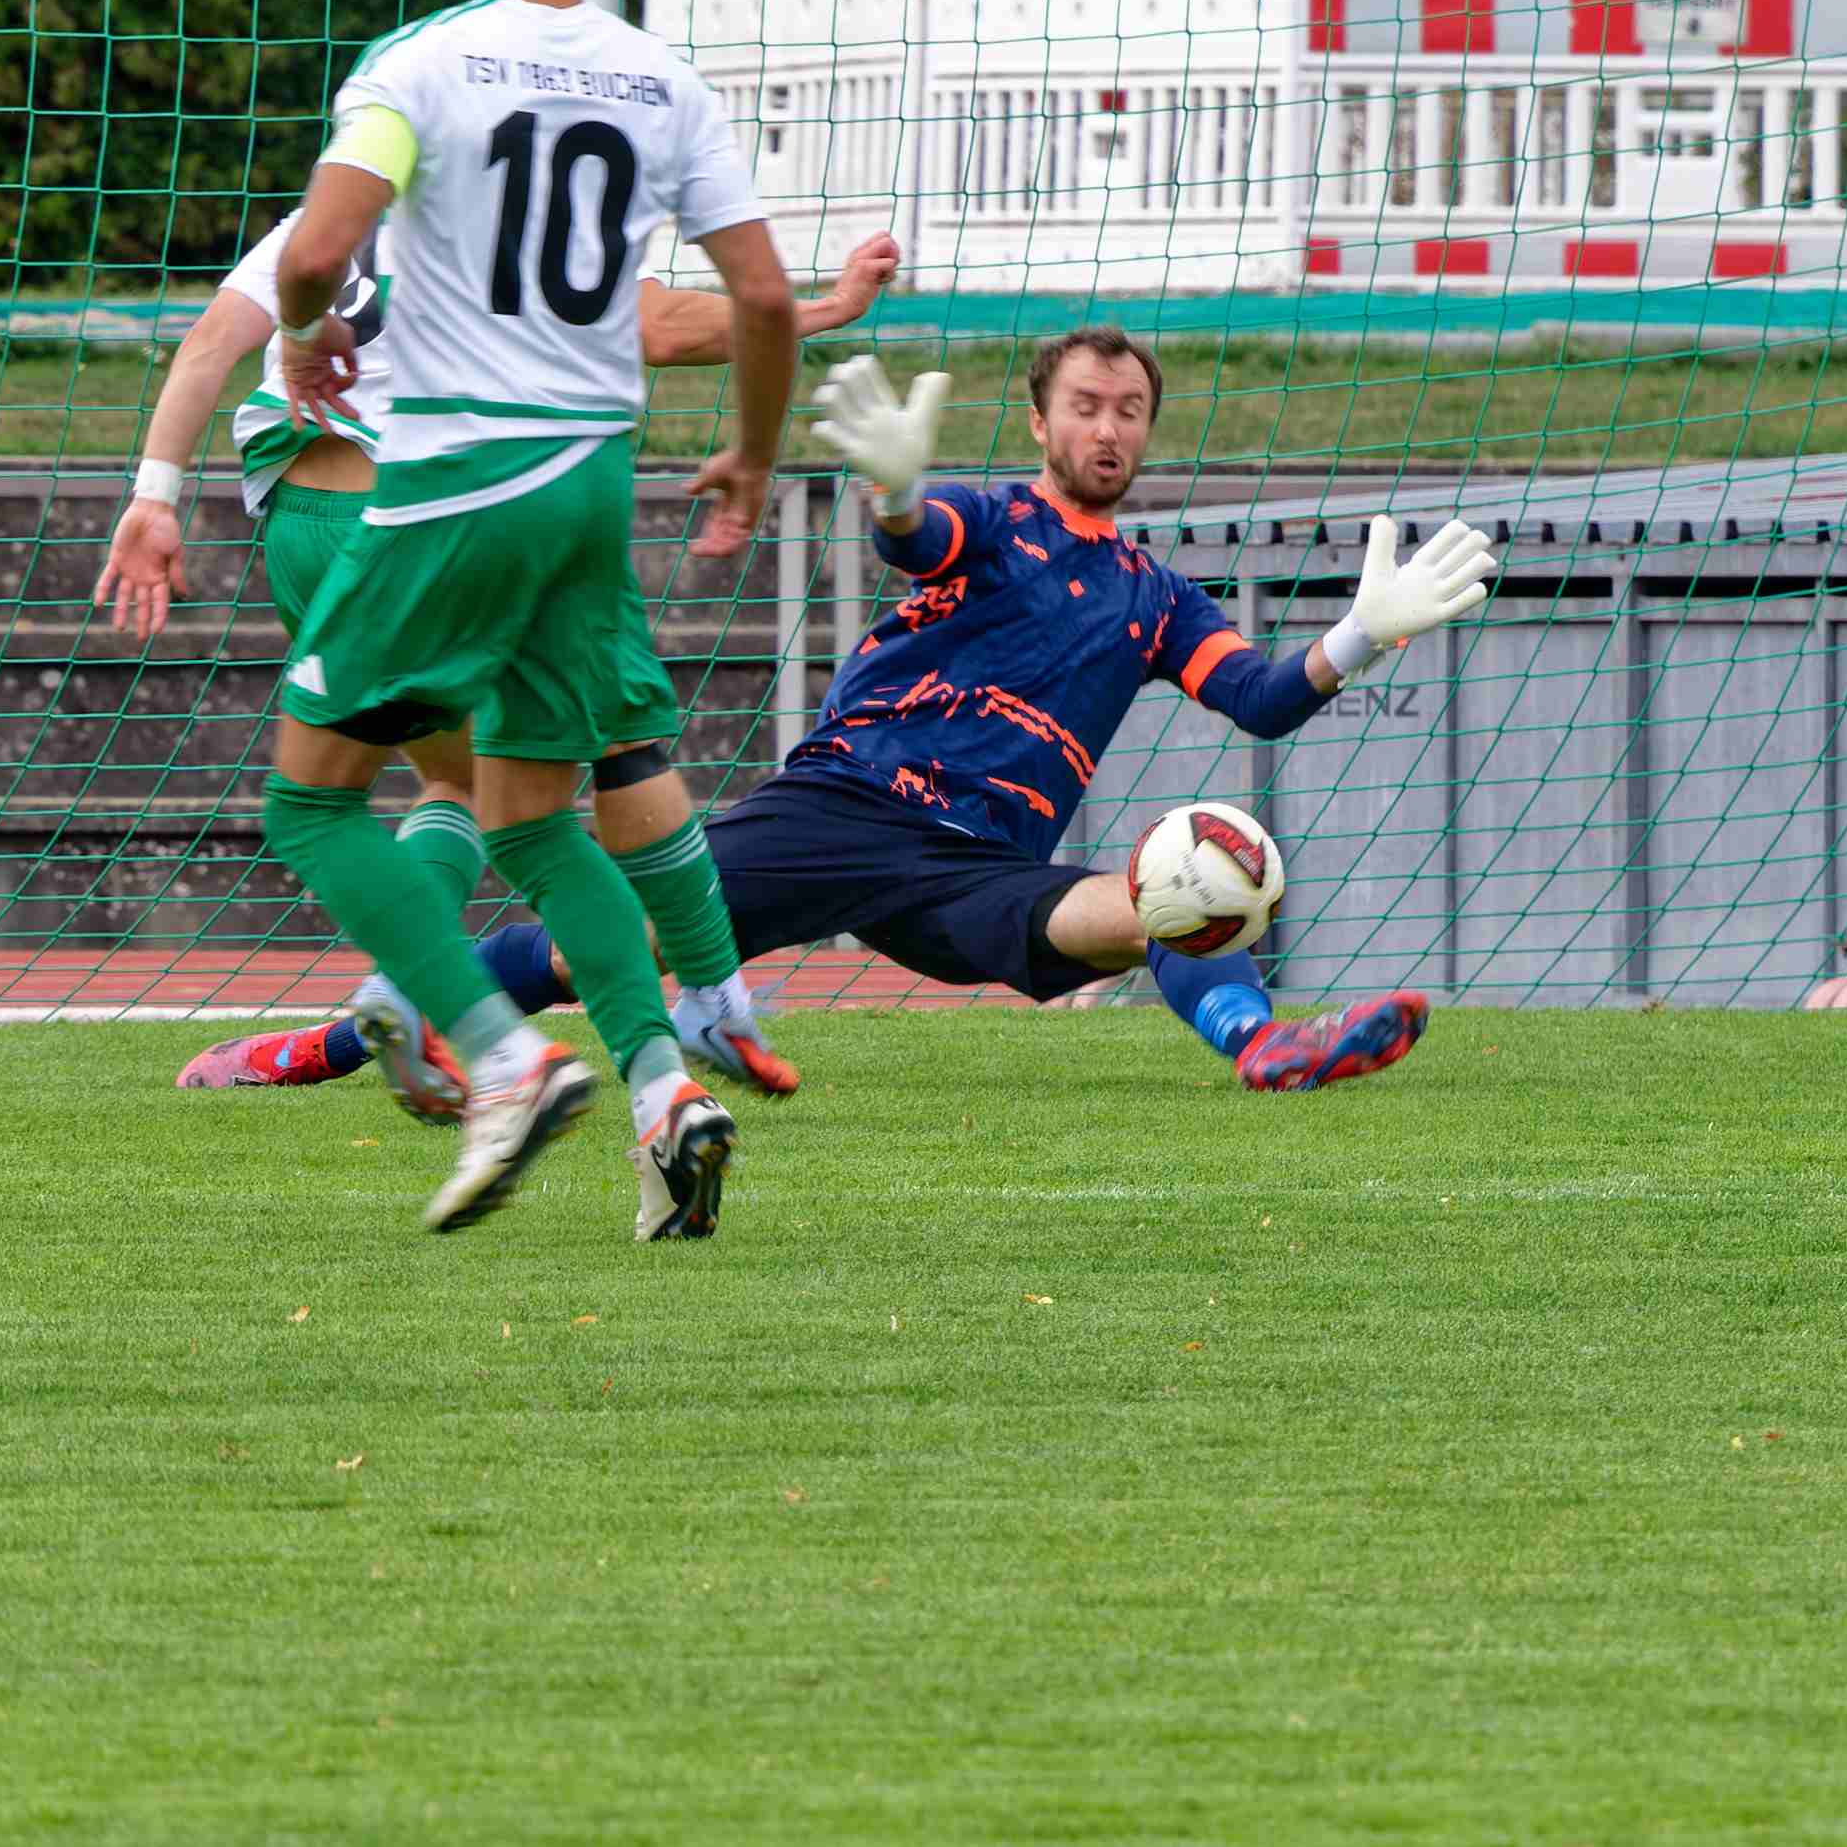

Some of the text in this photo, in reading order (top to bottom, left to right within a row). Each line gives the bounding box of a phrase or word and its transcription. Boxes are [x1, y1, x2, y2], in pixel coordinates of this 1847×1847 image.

[460, 53, 508, 84] TSV
[576, 68, 674, 107] BUCHEN
[482, 109, 639, 326] 10
